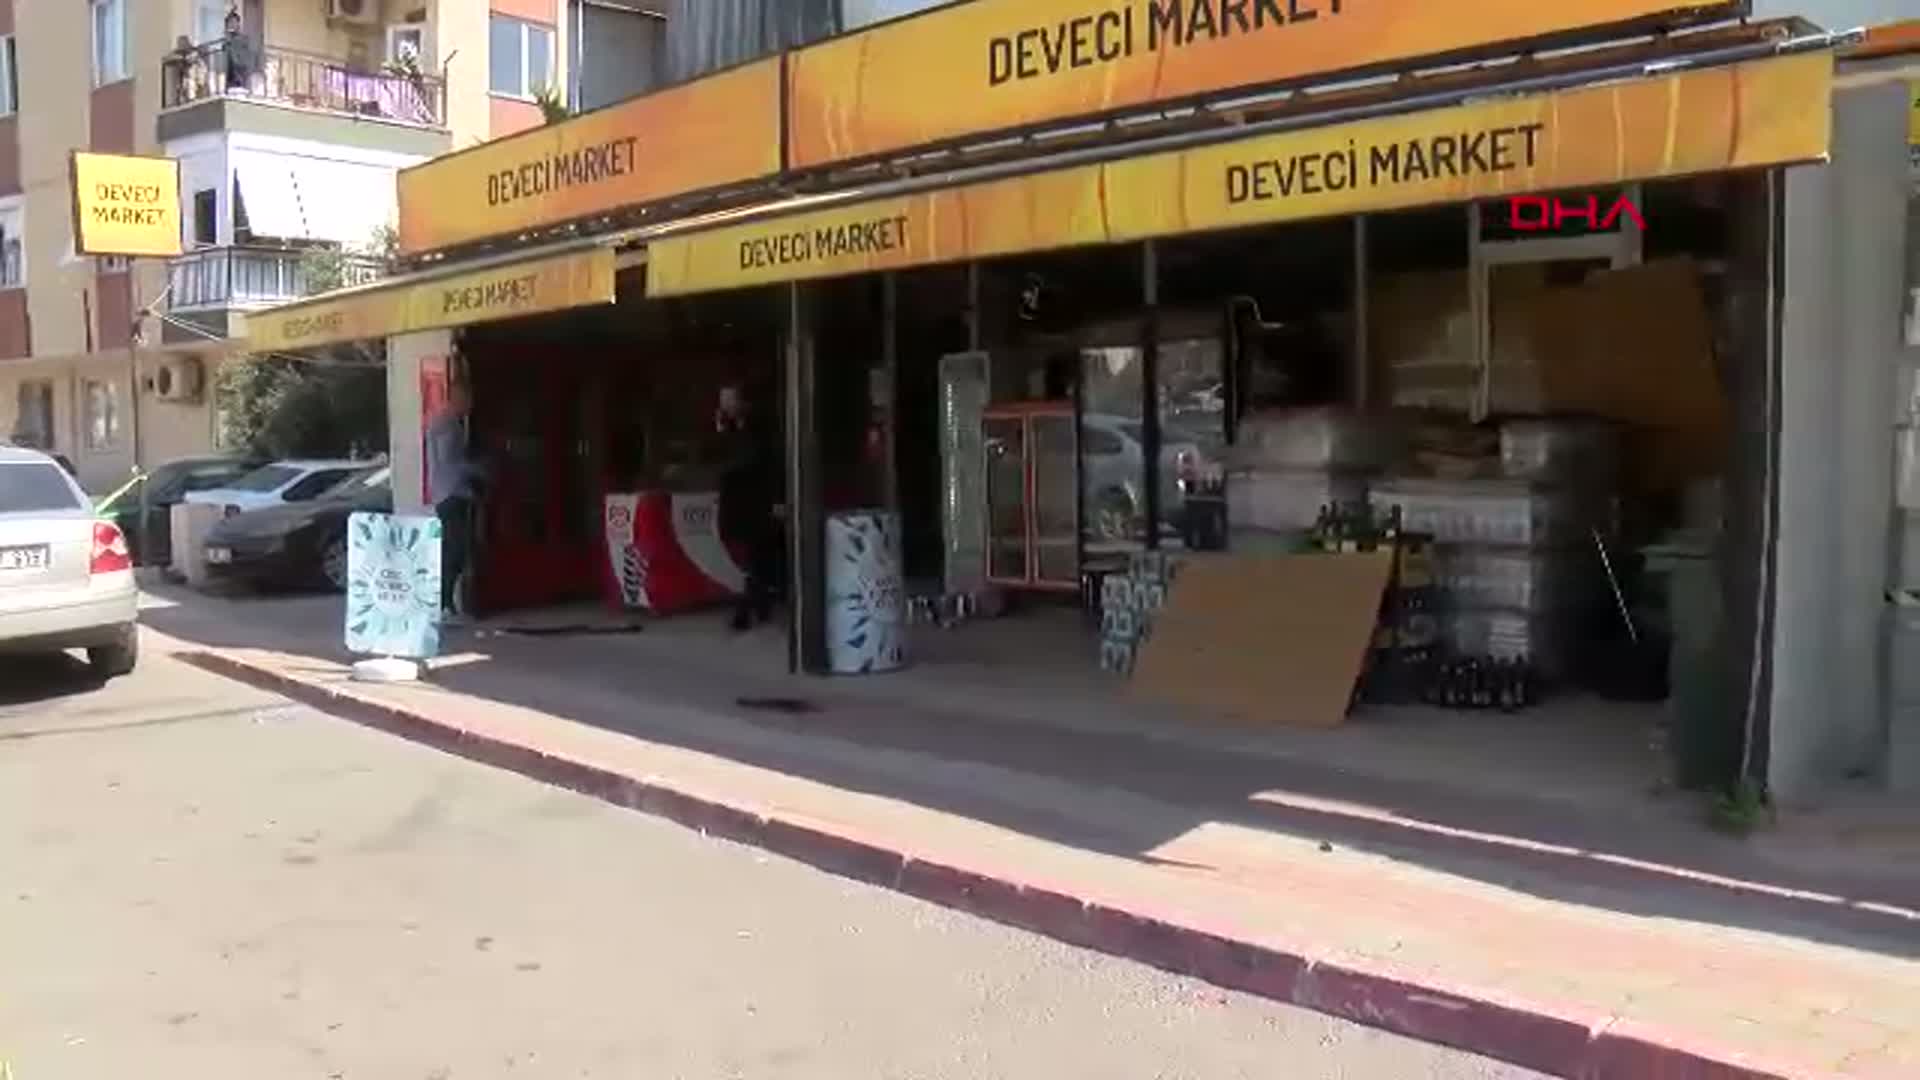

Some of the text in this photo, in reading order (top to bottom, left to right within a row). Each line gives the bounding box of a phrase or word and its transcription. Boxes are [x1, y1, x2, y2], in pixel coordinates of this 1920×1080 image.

[553, 136, 638, 190] MARKET
[1226, 123, 1544, 204] DEVECİ MARKET
[92, 206, 166, 225] MARKET
[815, 214, 908, 260] MARKET
